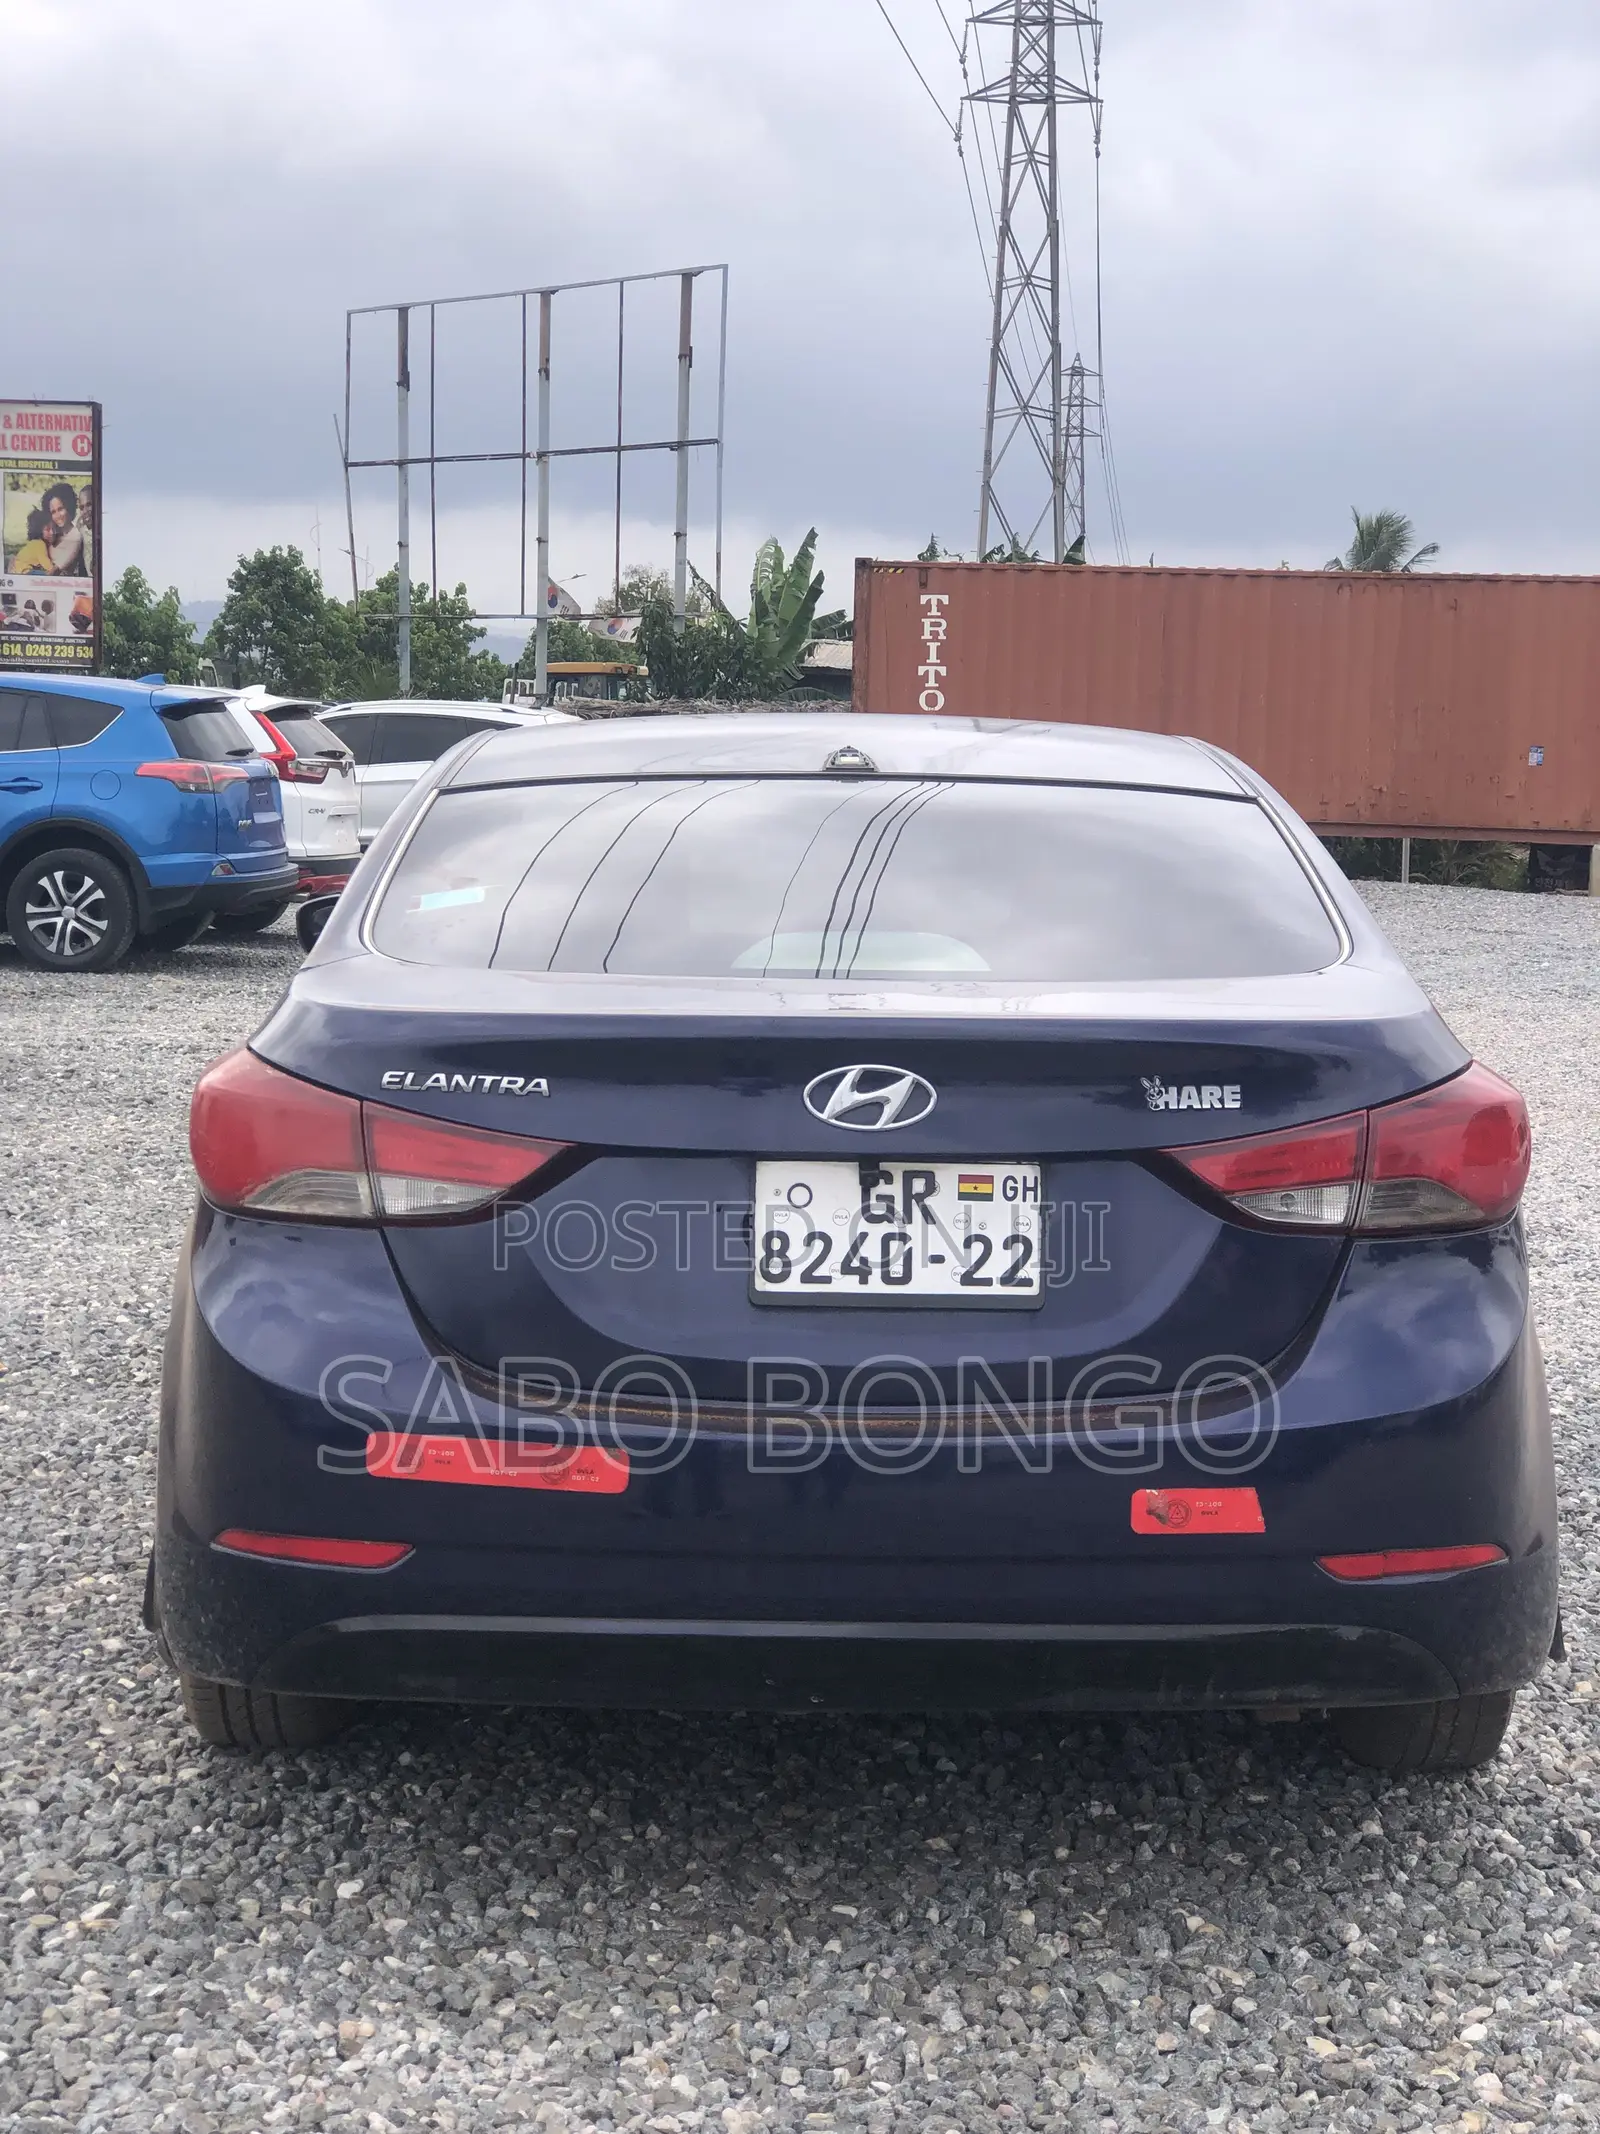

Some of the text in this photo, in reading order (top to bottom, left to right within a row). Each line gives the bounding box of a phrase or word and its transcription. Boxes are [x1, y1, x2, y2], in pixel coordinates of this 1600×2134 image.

[3, 412, 92, 432] & ALTERNATIV
[11, 434, 61, 453] CENTRE
[26, 644, 52, 656] 0243
[54, 645, 75, 658] 239
[76, 646, 93, 658] 534
[918, 594, 949, 712] TRITO
[381, 1070, 550, 1098] ELANTRA
[861, 1169, 1038, 1225] GR GH
